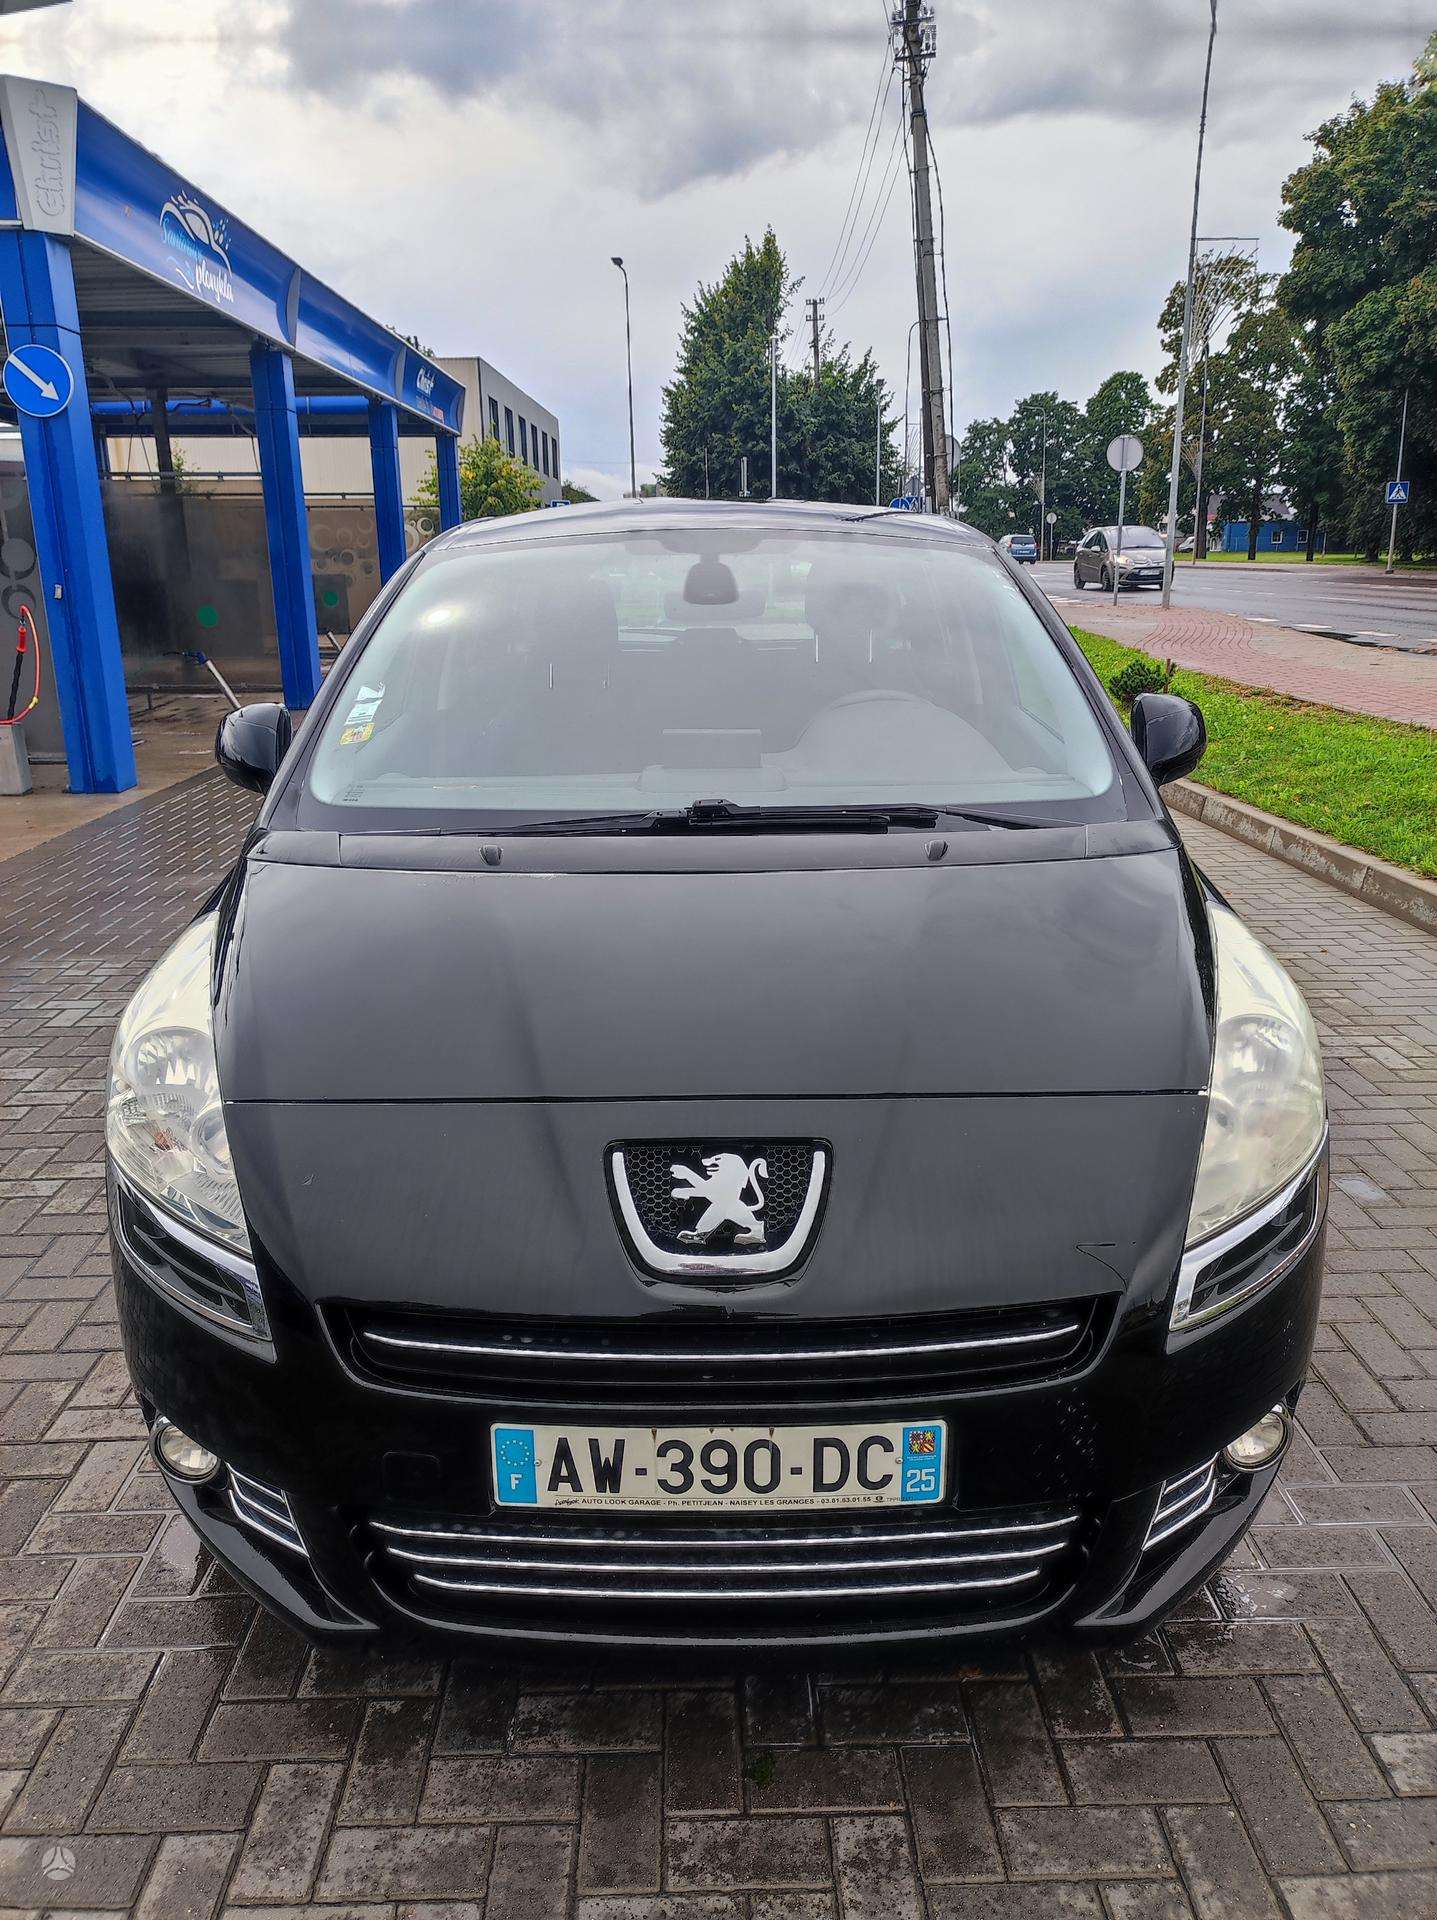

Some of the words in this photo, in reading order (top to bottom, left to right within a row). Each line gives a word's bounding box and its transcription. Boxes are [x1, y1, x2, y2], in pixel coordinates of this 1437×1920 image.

[547, 1435, 895, 1495] AW-390-DC
[510, 1473, 523, 1490] F
[906, 1468, 936, 1493] 25
